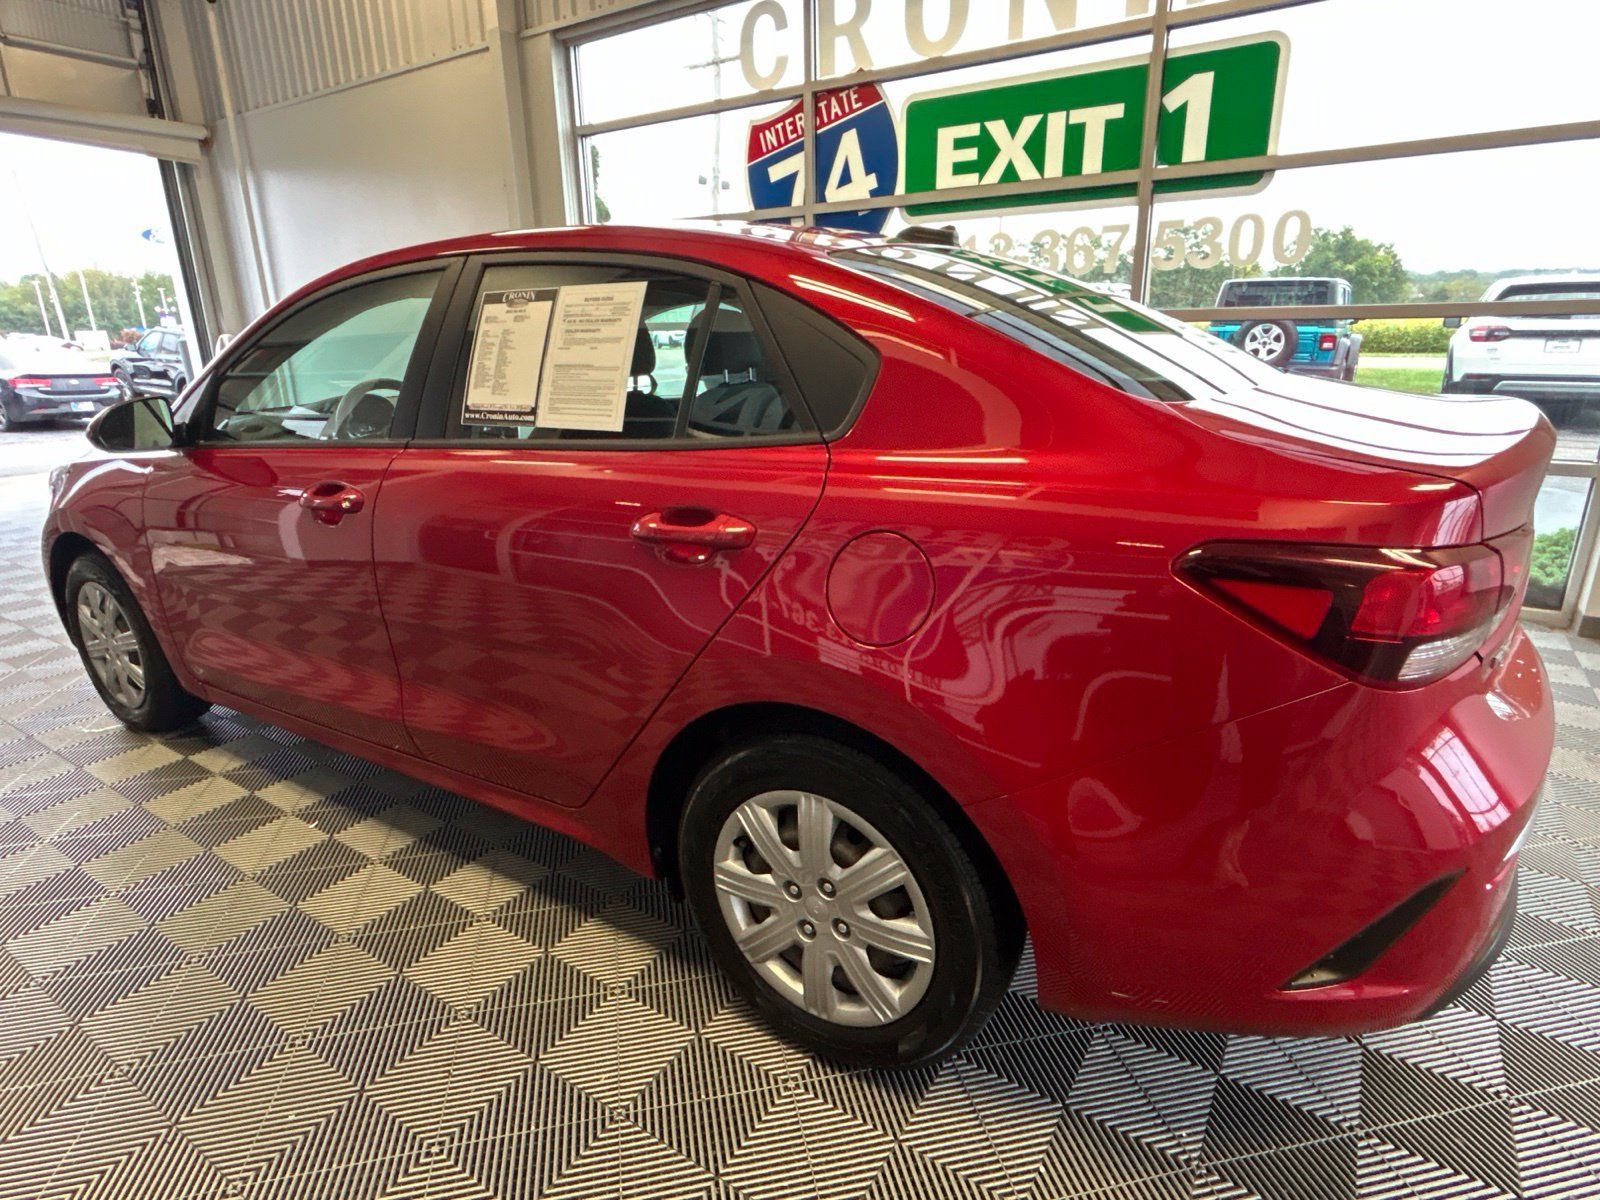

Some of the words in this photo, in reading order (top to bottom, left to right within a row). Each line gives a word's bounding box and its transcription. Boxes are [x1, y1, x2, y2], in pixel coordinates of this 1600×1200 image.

[740, 0, 1197, 91] CRO
[759, 87, 863, 154] INTERTATE
[935, 102, 1125, 190] EXIT
[1161, 70, 1216, 163] 1
[767, 127, 879, 223] 74
[465, 411, 535, 422] www.CroninAuto.com
